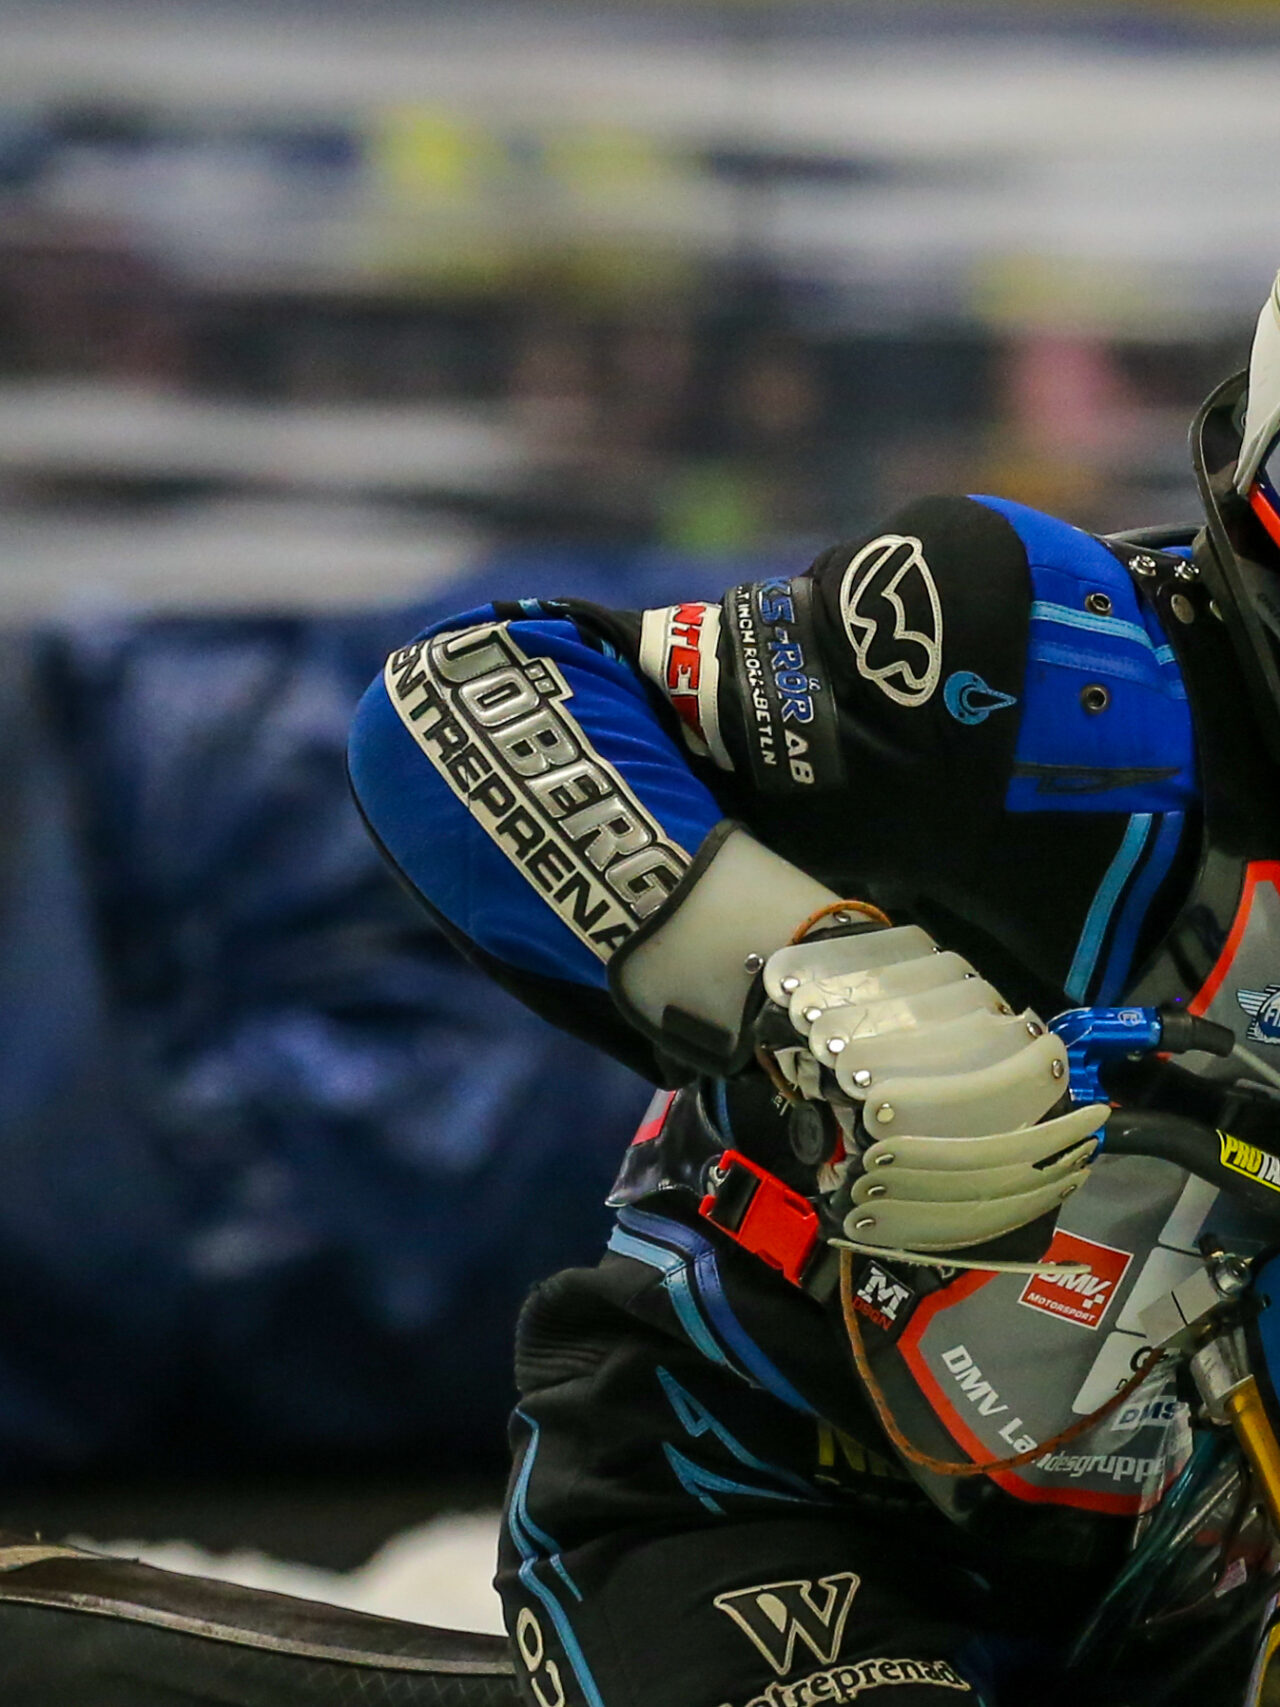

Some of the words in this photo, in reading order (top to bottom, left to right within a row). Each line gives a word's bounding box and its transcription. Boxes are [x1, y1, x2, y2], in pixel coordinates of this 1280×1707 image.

[784, 728, 815, 785] AB
[1027, 1292, 1096, 1323] MOTORSPORT
[941, 1344, 1009, 1417] DMV
